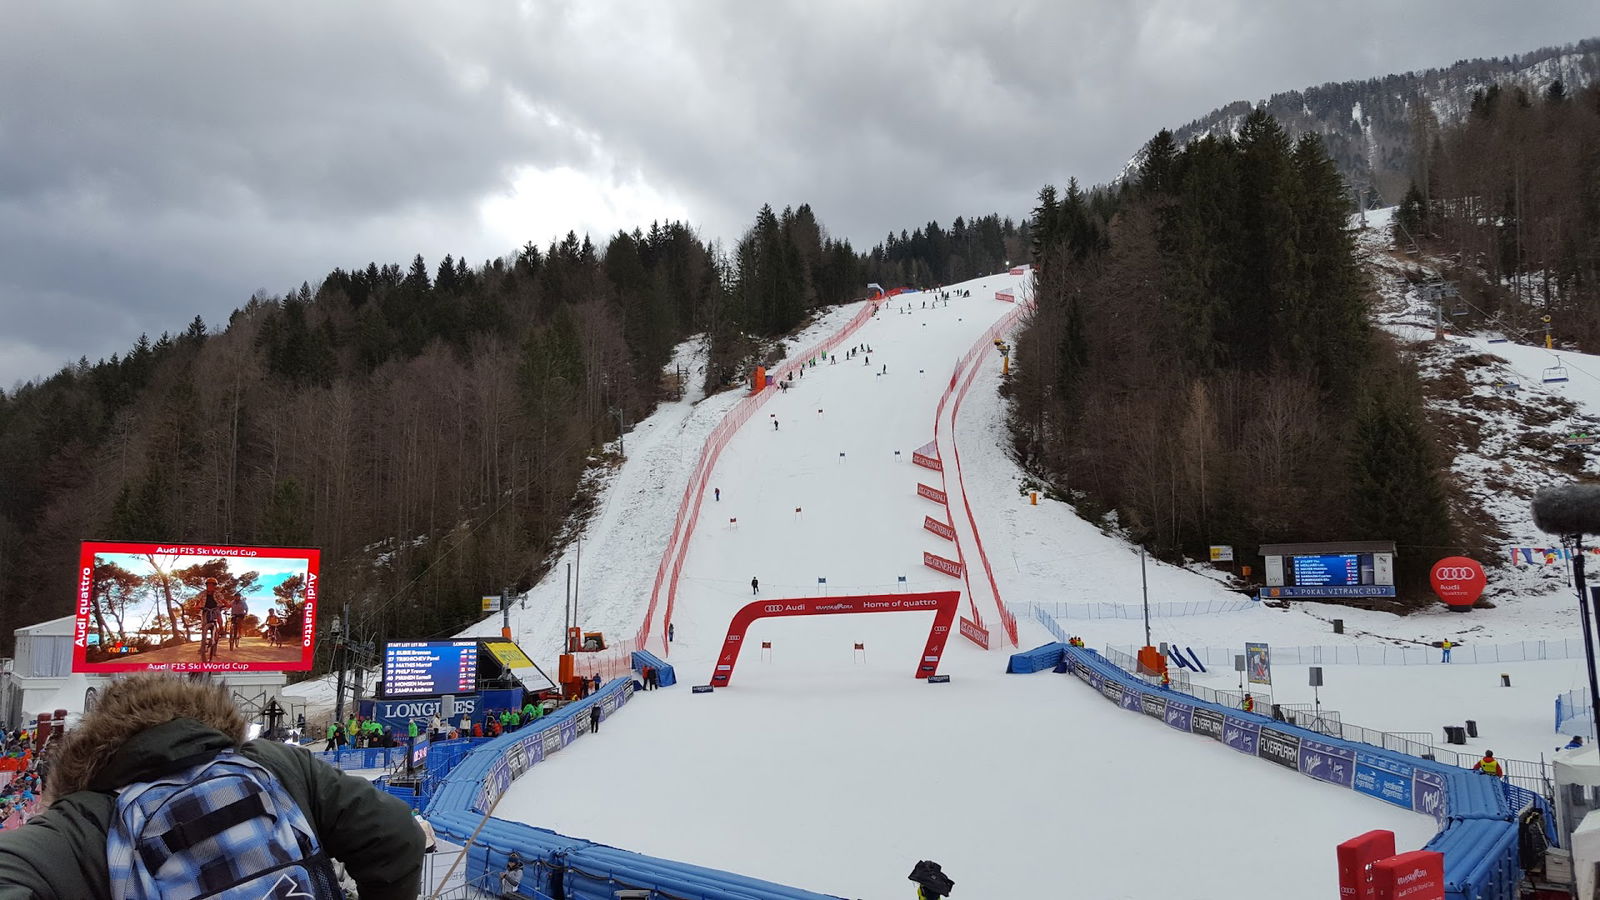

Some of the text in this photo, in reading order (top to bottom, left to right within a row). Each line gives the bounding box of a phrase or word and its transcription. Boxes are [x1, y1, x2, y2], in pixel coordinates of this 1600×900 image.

[156, 546, 179, 554] Audi
[197, 547, 210, 555] Ski
[211, 548, 239, 556] World
[240, 549, 257, 558] Cup
[80, 567, 91, 614] quattro
[308, 572, 317, 601] Audi
[904, 599, 938, 609] quattro
[75, 617, 87, 647] Audi
[303, 601, 316, 648] quattro
[147, 662, 249, 671] Audi FIS Ski World Cup
[385, 700, 475, 718] LONGIES
[1193, 716, 1222, 735] FLYERALARM
[1260, 738, 1297, 762] FLYERALARM
